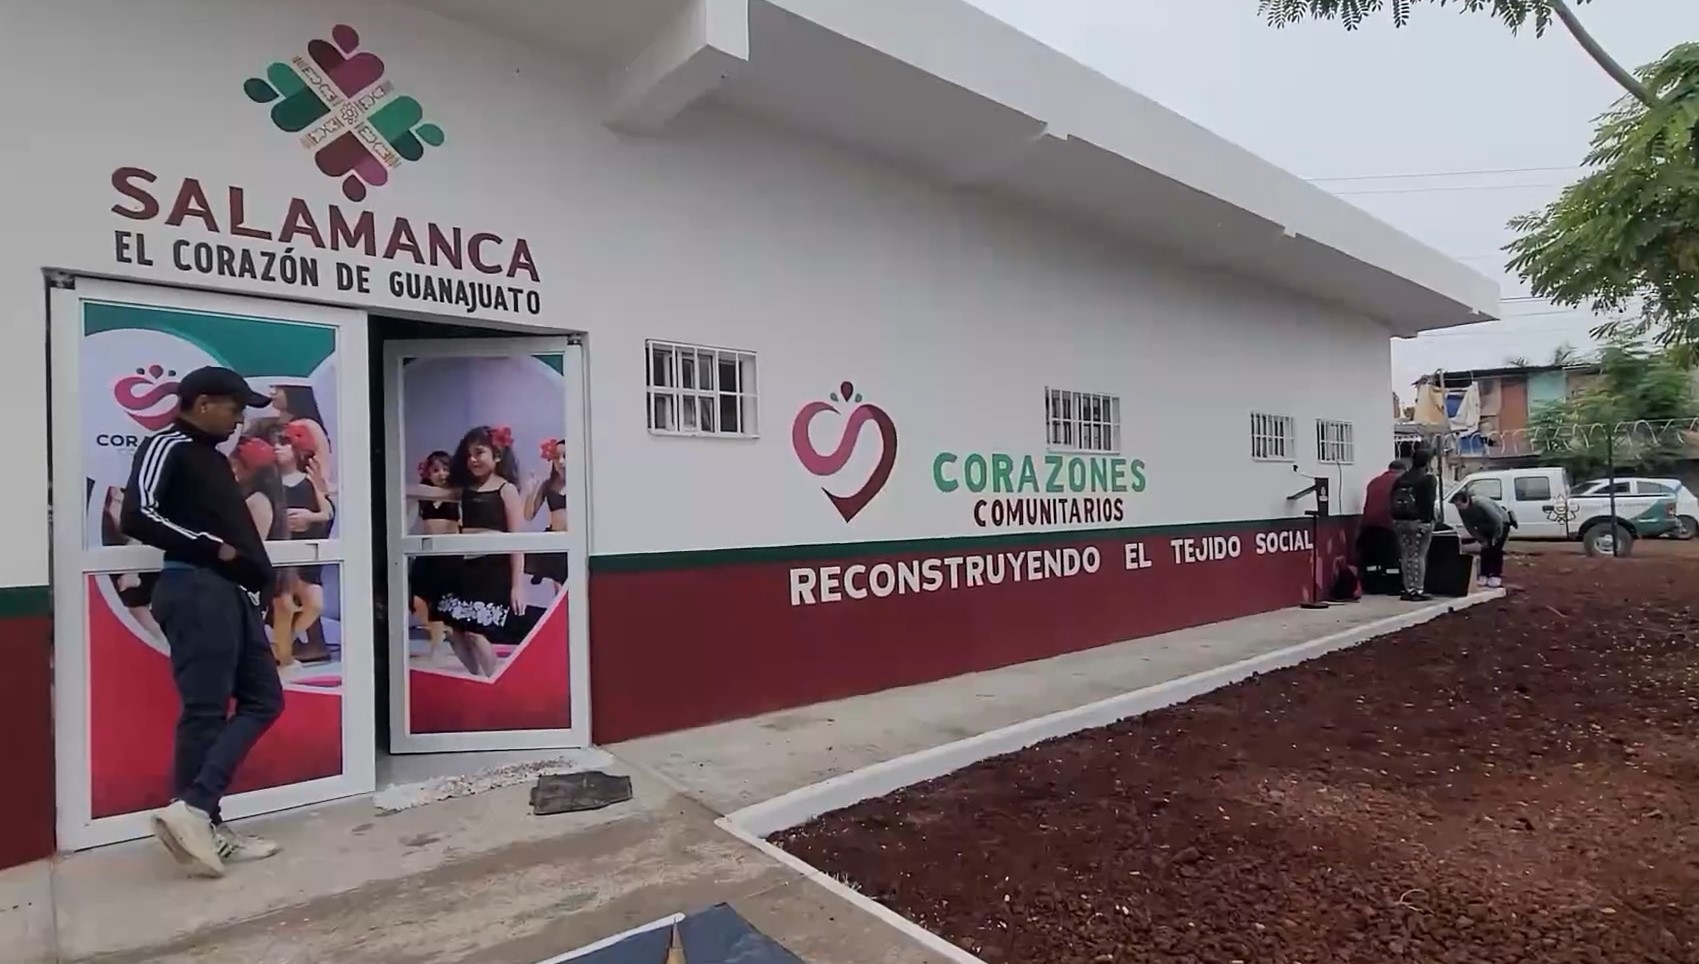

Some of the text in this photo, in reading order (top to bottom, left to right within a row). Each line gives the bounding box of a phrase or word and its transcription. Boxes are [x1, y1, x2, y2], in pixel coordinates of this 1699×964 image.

[111, 166, 540, 283] SALAMANCA
[115, 231, 541, 315] EL CORAZÓN DE GUANAJUATO
[933, 452, 1147, 494] CORAZONES
[974, 497, 1125, 527] COMUNITARIOS
[790, 530, 1314, 606] RECONSTRUYENDO EL TEJIDO SOCIAL
